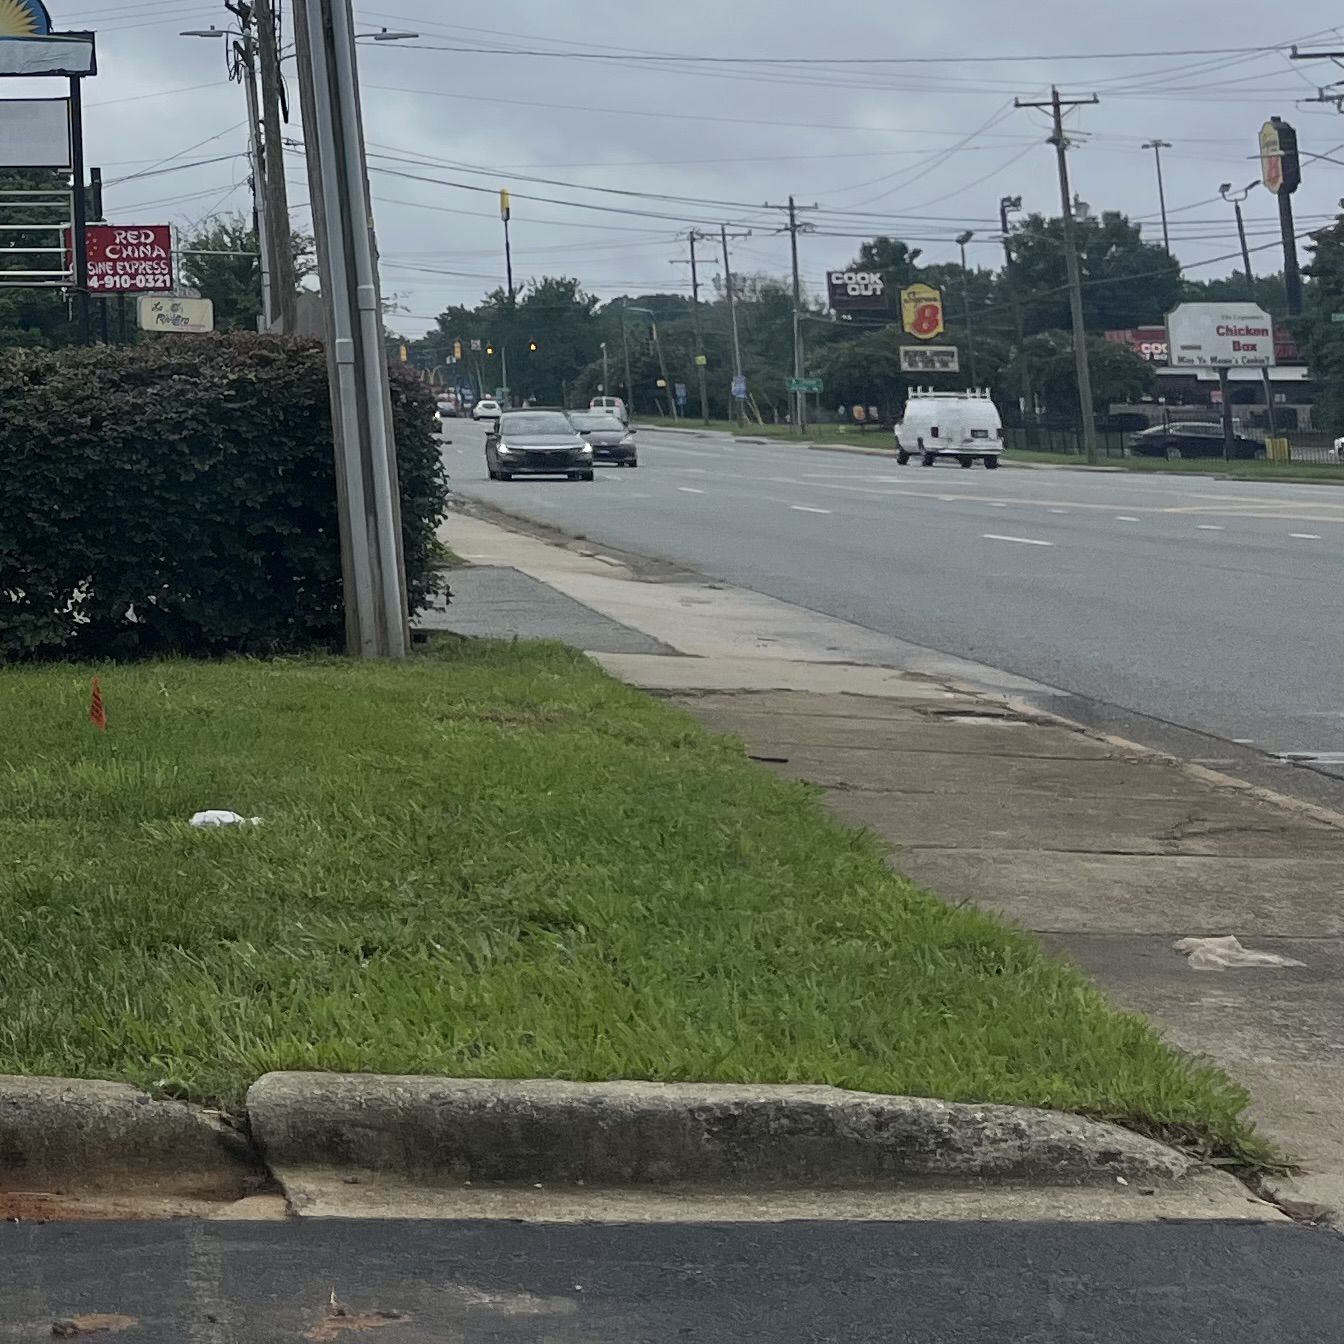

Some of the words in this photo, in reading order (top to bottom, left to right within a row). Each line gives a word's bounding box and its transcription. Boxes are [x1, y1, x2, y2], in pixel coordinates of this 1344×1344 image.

[113, 230, 155, 244] RED
[105, 244, 167, 259] CHINA
[87, 260, 114, 275] SINE
[116, 260, 169, 275] EXPRESS
[87, 274, 171, 288] 4-910-0321
[831, 272, 882, 284] COOK
[847, 283, 883, 296] OUT
[912, 304, 939, 334] 8
[1216, 325, 1269, 337] Chicken
[1232, 340, 1257, 352] Box
